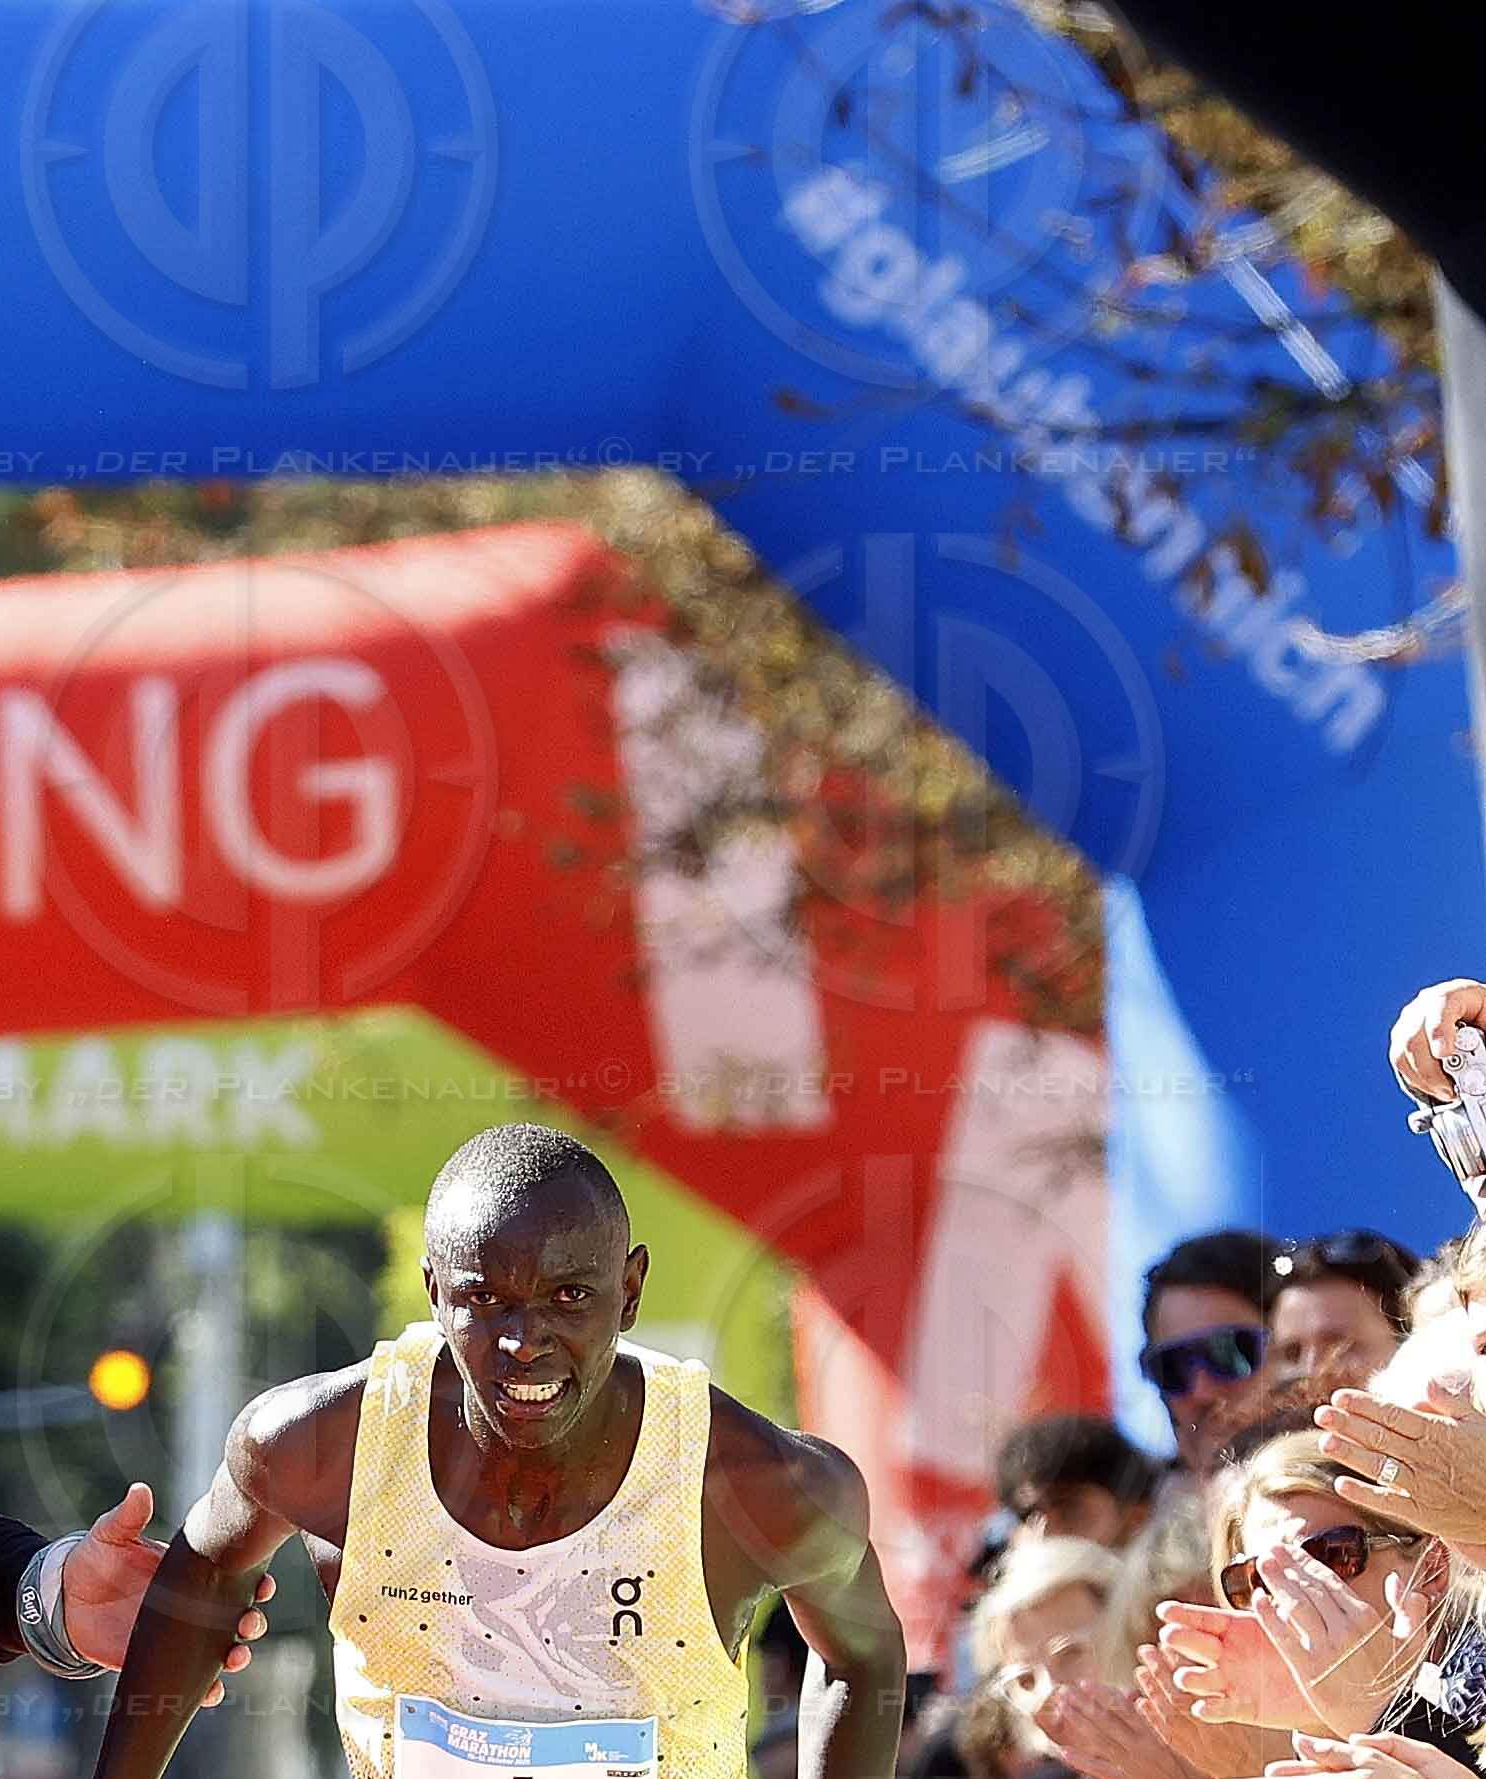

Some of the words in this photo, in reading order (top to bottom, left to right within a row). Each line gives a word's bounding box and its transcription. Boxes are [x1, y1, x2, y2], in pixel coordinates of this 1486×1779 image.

[22, 1590, 40, 1620] Buff
[381, 1584, 475, 1606] run2gether
[449, 1723, 488, 1744] GRAZ
[448, 1734, 532, 1759] MARATHON
